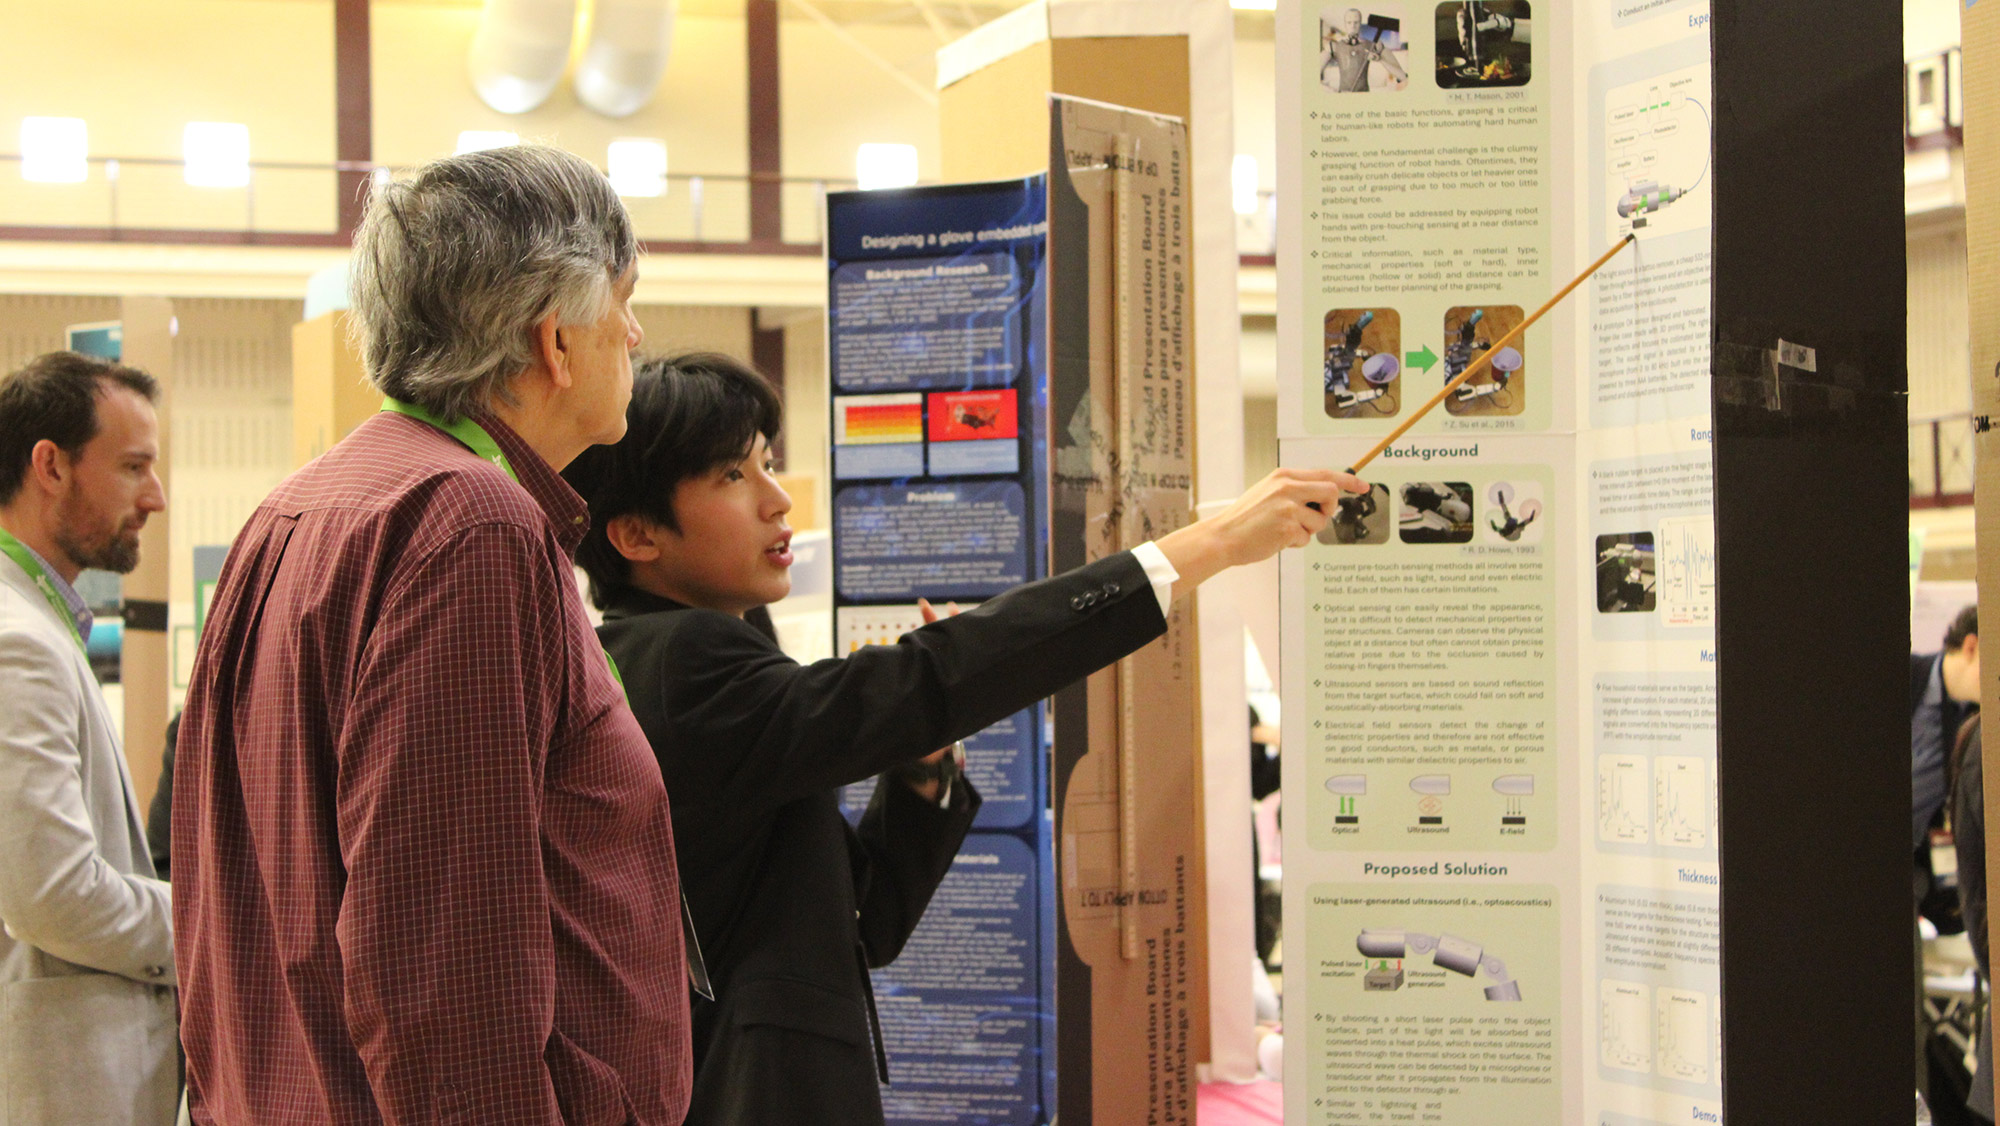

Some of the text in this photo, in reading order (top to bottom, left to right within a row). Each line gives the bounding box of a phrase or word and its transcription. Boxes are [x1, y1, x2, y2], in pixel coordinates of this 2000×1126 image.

[1321, 111, 1331, 119] As
[1355, 110, 1363, 118] of
[1367, 109, 1380, 117] the
[1385, 108, 1407, 117] basic
[1412, 107, 1454, 117] functions,
[1458, 106, 1493, 116] grasping
[1497, 105, 1504, 113] is
[1508, 104, 1537, 113] critical
[1321, 134, 1351, 142] labors.
[1321, 149, 1360, 159] However,
[1381, 147, 1434, 156] fundamental
[1437, 146, 1478, 156] challenge
[1481, 145, 1488, 153] is
[1491, 145, 1504, 153] the
[1507, 144, 1537, 154] clumsy
[1321, 155, 1538, 171] grasping function of robot hands. Oftentimes, they
[1168, 149, 1180, 197] batta
[1321, 195, 1383, 206] grabbing force.
[1142, 195, 1152, 251] Board
[1170, 205, 1181, 247] trois
[862, 234, 924, 249] Designing
[927, 234, 936, 245] a
[939, 231, 974, 247] glove
[1322, 233, 1388, 244] from the object.
[1156, 188, 1168, 331] presentaciones
[1322, 250, 1352, 258] Critical
[1362, 248, 1414, 258] information,
[1423, 248, 1443, 256] such
[1473, 246, 1507, 254] material
[1518, 245, 1540, 255] type,
[866, 263, 988, 280] Background Research
[1322, 261, 1370, 270] mechanical
[1381, 259, 1424, 270] properties
[1434, 259, 1452, 269] (soft
[1482, 257, 1508, 268] hard),
[1517, 257, 1538, 265] inner
[1142, 259, 1154, 379] Presentation
[1170, 272, 1184, 372] d'affichage
[1158, 338, 1170, 380] para
[1173, 379, 1185, 460] Panneau
[1384, 444, 1478, 461] Background
[1324, 562, 1355, 570] Current
[1358, 562, 1398, 572] pre-touch
[1401, 562, 1433, 572] sensing
[1436, 562, 1472, 570] methods
[1324, 604, 1354, 613] Optical
[1359, 603, 1391, 613] sensing
[1414, 603, 1438, 613] easily
[1443, 603, 1468, 611] reveal
[1472, 603, 1485, 611] the
[1490, 604, 1544, 613] appearance,
[1324, 661, 1449, 671] closing-in fingers themselves.
[1429, 679, 1454, 687] based
[1473, 679, 1499, 687] sound
[1503, 679, 1544, 687] reflection
[1325, 703, 1464, 713] acoustically-absorbing materials.
[1325, 732, 1363, 740] dielectric
[1367, 732, 1410, 742] properties
[1414, 732, 1429, 740] and
[1433, 732, 1470, 740] therefore
[1491, 732, 1504, 740] not
[1508, 732, 1544, 740] effective
[1407, 826, 1450, 834] Ultrasound
[1364, 862, 1508, 878] Proposed Solution
[1678, 869, 1718, 885] Thickness
[1175, 855, 1185, 934] battants
[1314, 896, 1551, 908] Using laser-generated ultrasound (i.e., optoacoustics)
[1174, 940, 1186, 983] trois
[1145, 938, 1157, 1126] Presentation Board
[1161, 927, 1175, 1122] para presentaciones
[1176, 1008, 1188, 1110] d'affichage
[1693, 1106, 1717, 1123] Demo
